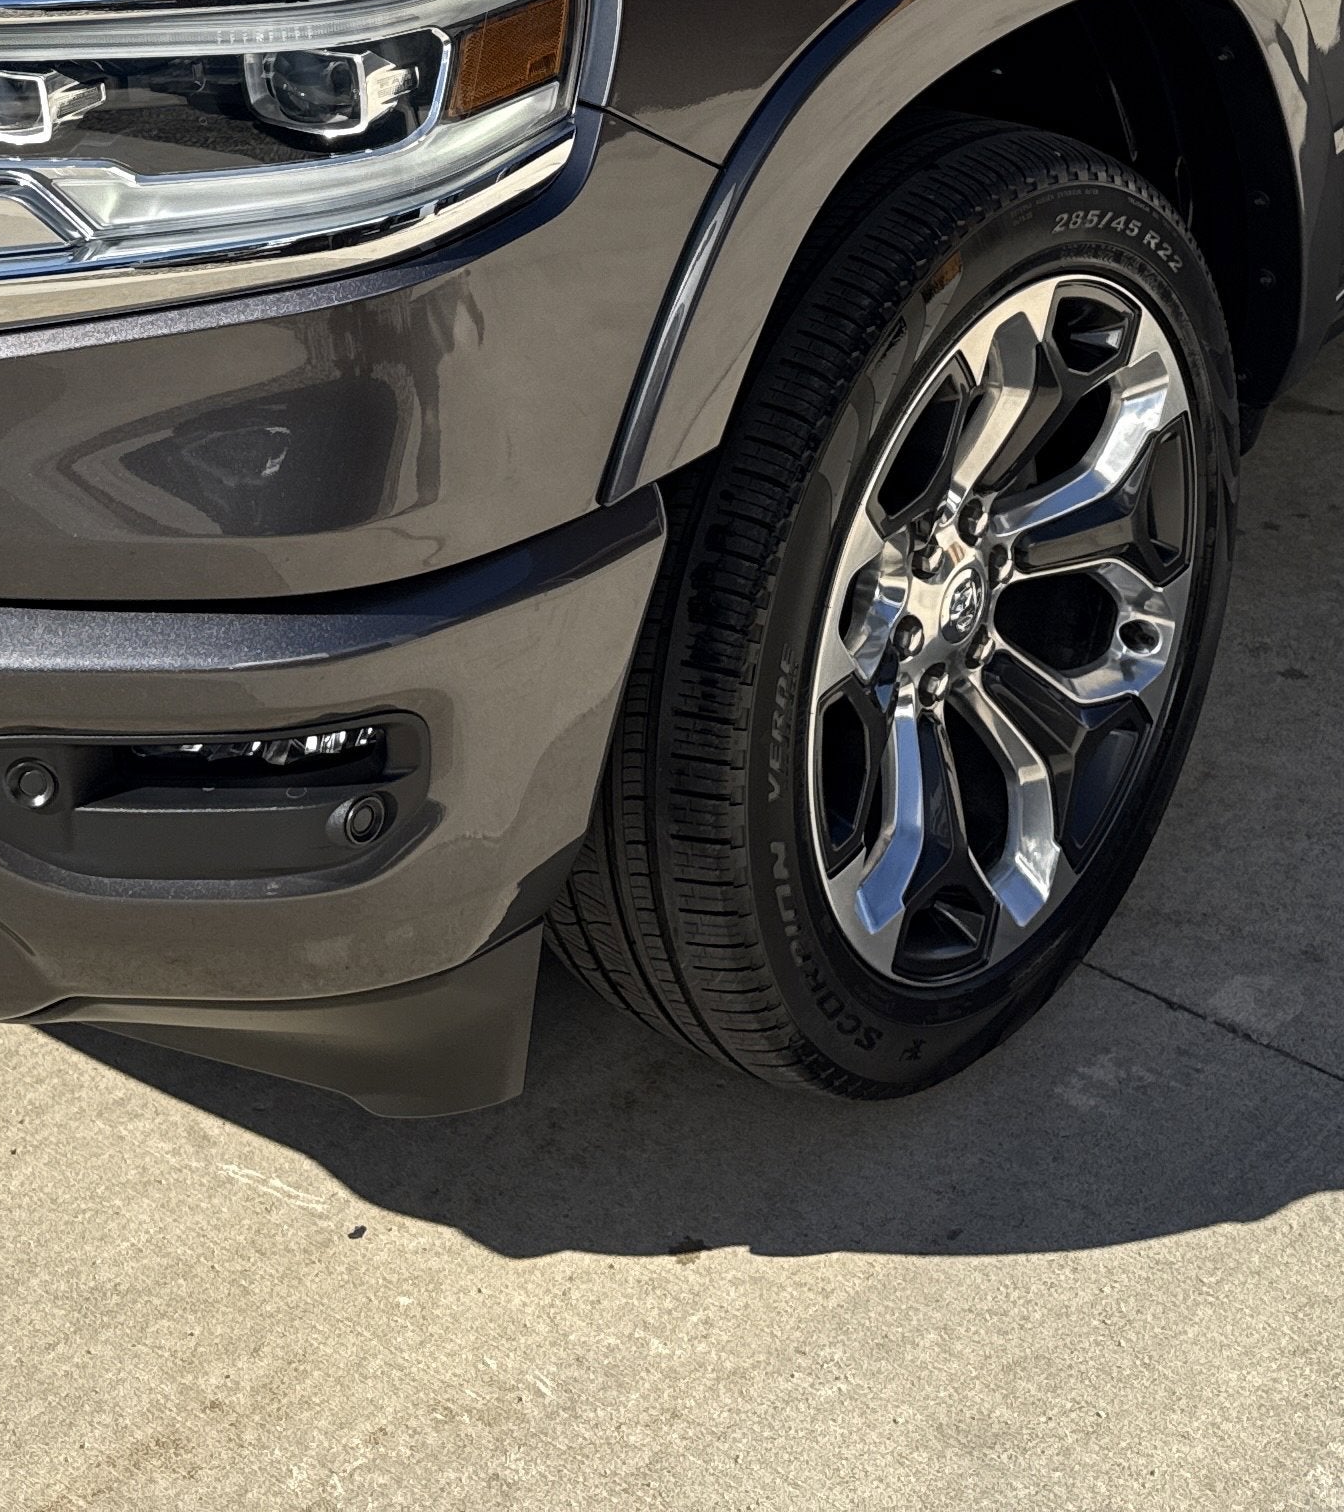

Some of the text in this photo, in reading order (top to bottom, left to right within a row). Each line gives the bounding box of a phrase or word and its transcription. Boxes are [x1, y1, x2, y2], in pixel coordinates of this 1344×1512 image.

[1051, 209, 1184, 274] 285/45 R22
[767, 642, 885, 1052] SCORPION VERDE
